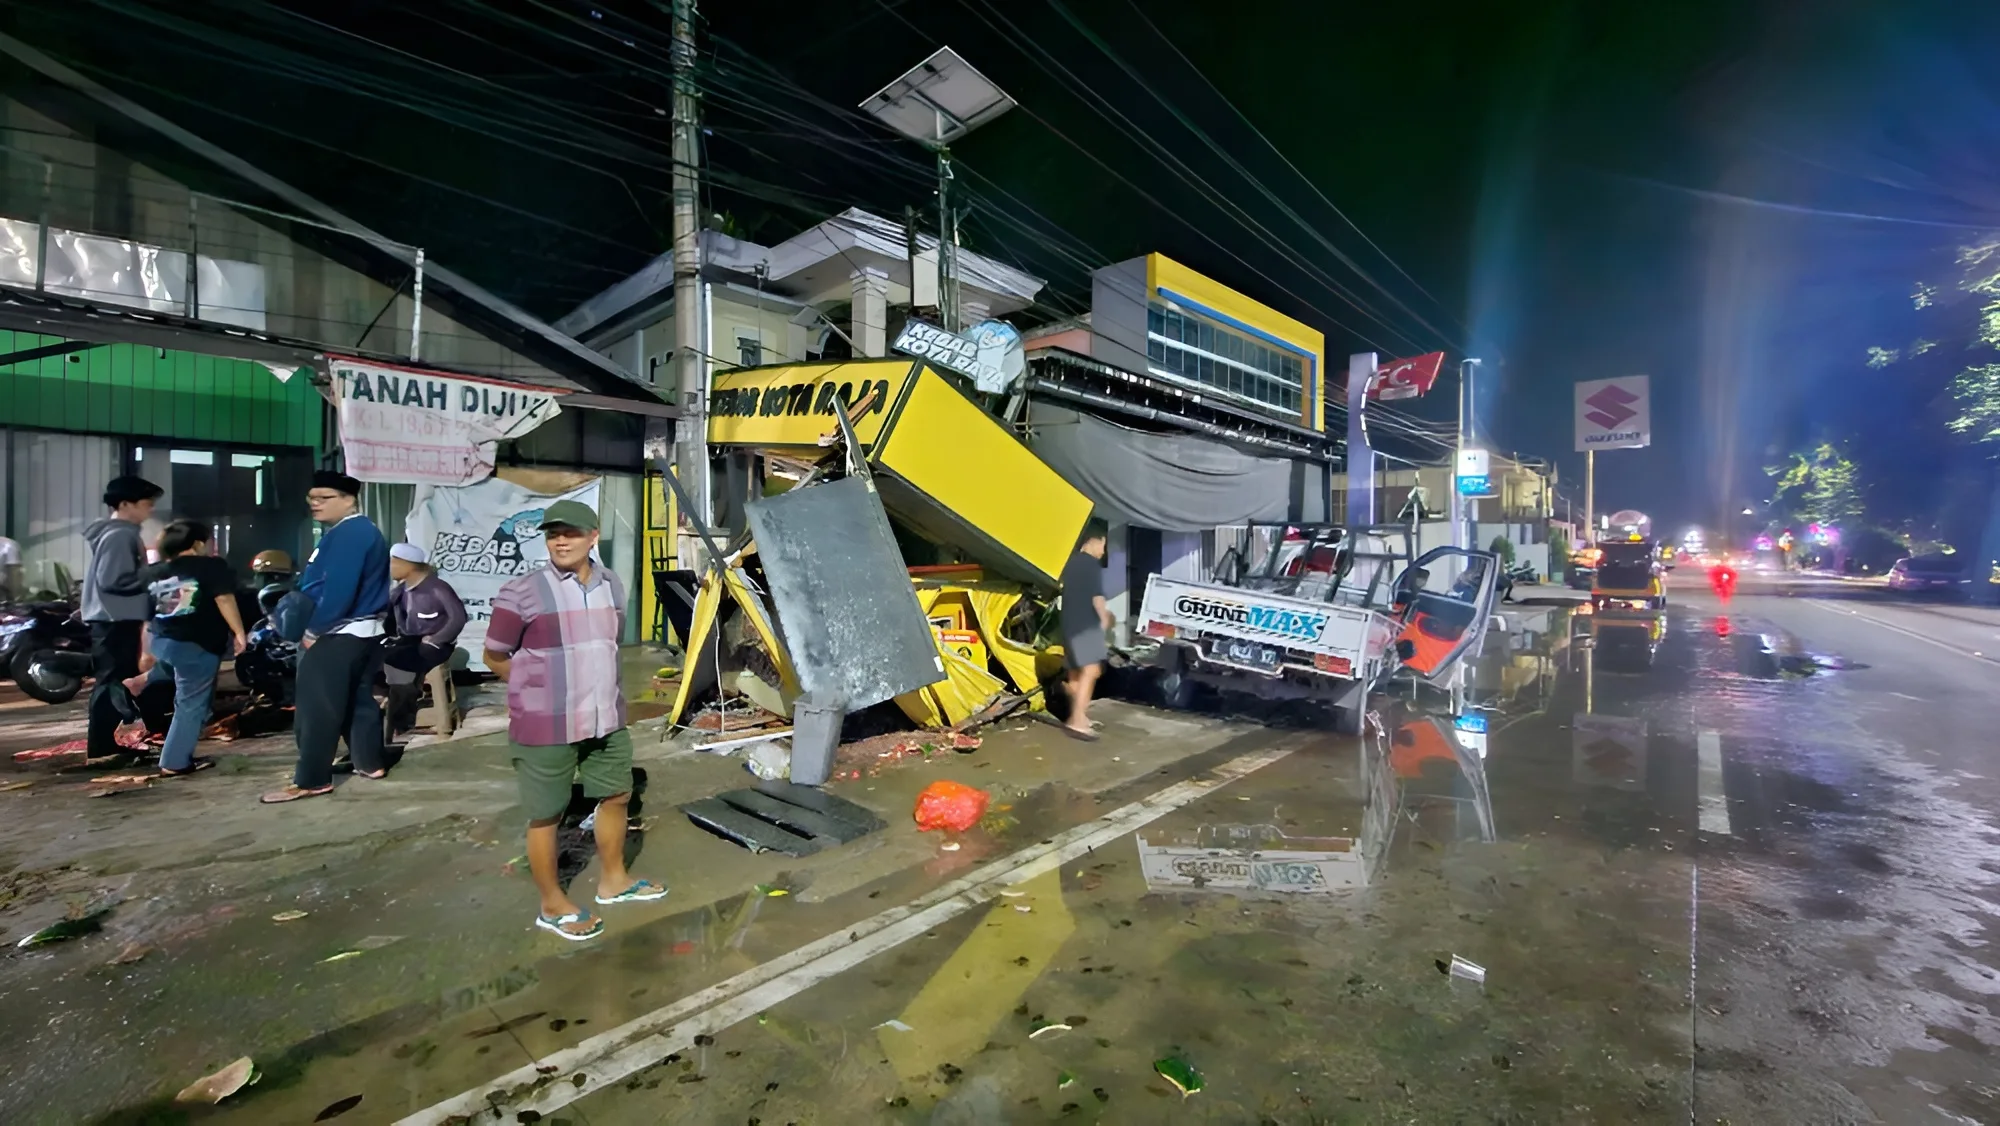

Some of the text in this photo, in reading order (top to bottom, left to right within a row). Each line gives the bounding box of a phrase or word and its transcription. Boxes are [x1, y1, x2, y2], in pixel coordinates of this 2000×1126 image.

[337, 369, 447, 411] TANAH
[435, 531, 518, 557] KEBAB
[430, 551, 494, 575] KOTA
